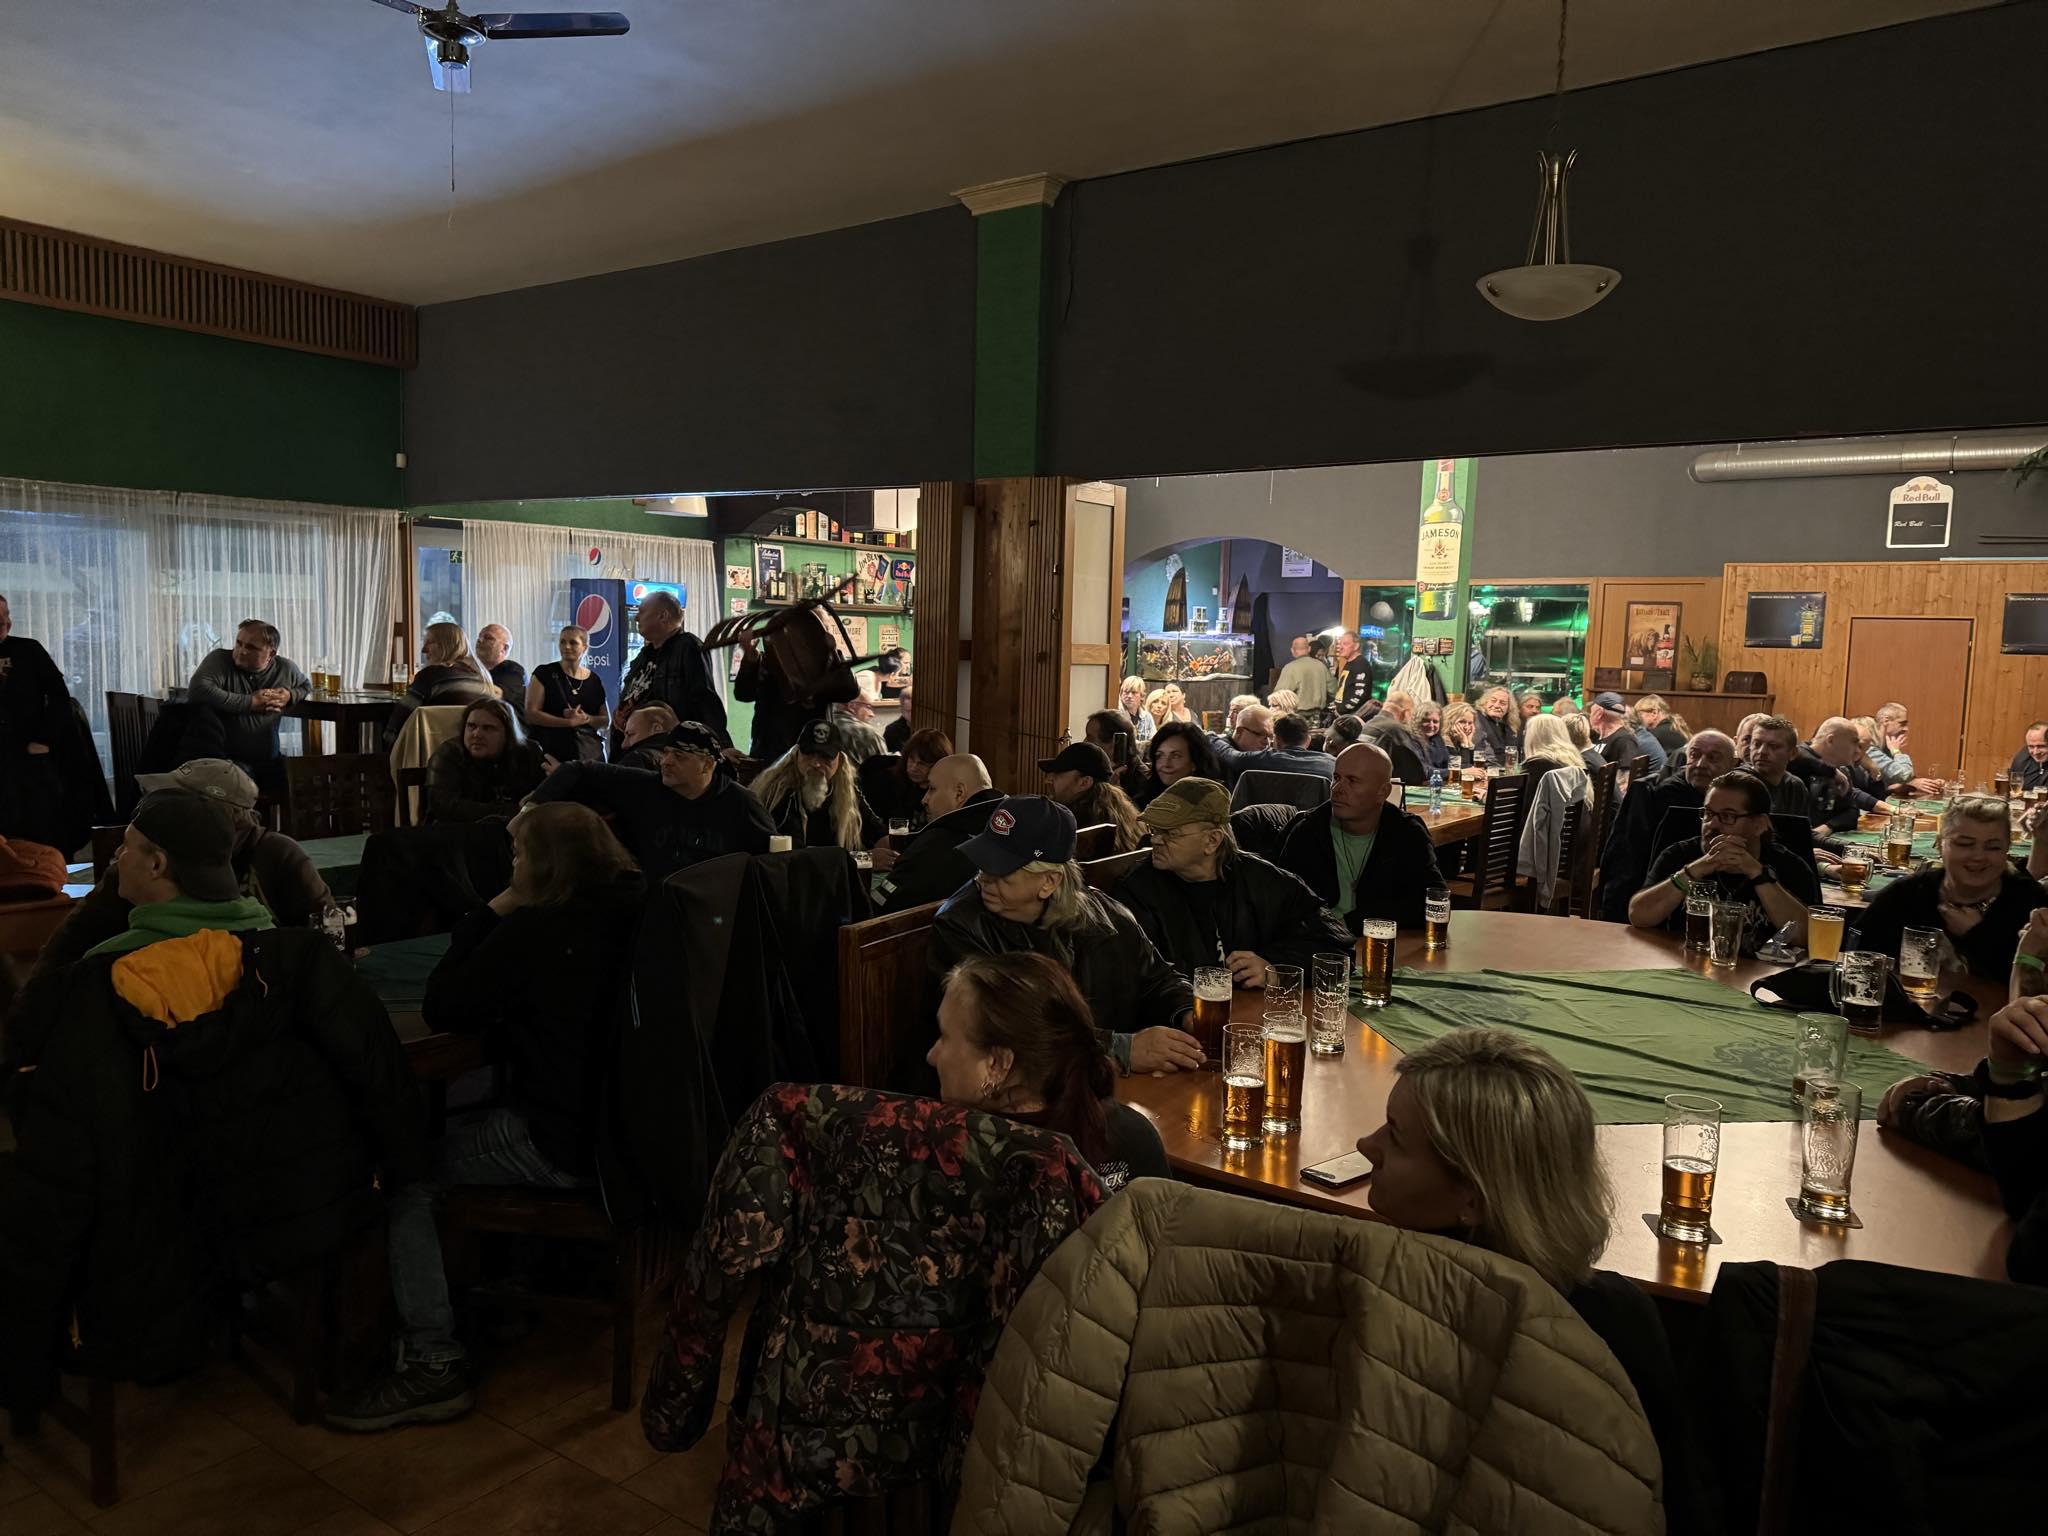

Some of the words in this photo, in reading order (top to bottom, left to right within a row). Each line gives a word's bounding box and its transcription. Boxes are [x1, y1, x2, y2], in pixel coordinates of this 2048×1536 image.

[1903, 493, 1921, 502] Red
[1922, 493, 1940, 501] Bull
[1421, 528, 1460, 541] JAMESON
[586, 653, 611, 669] epsi
